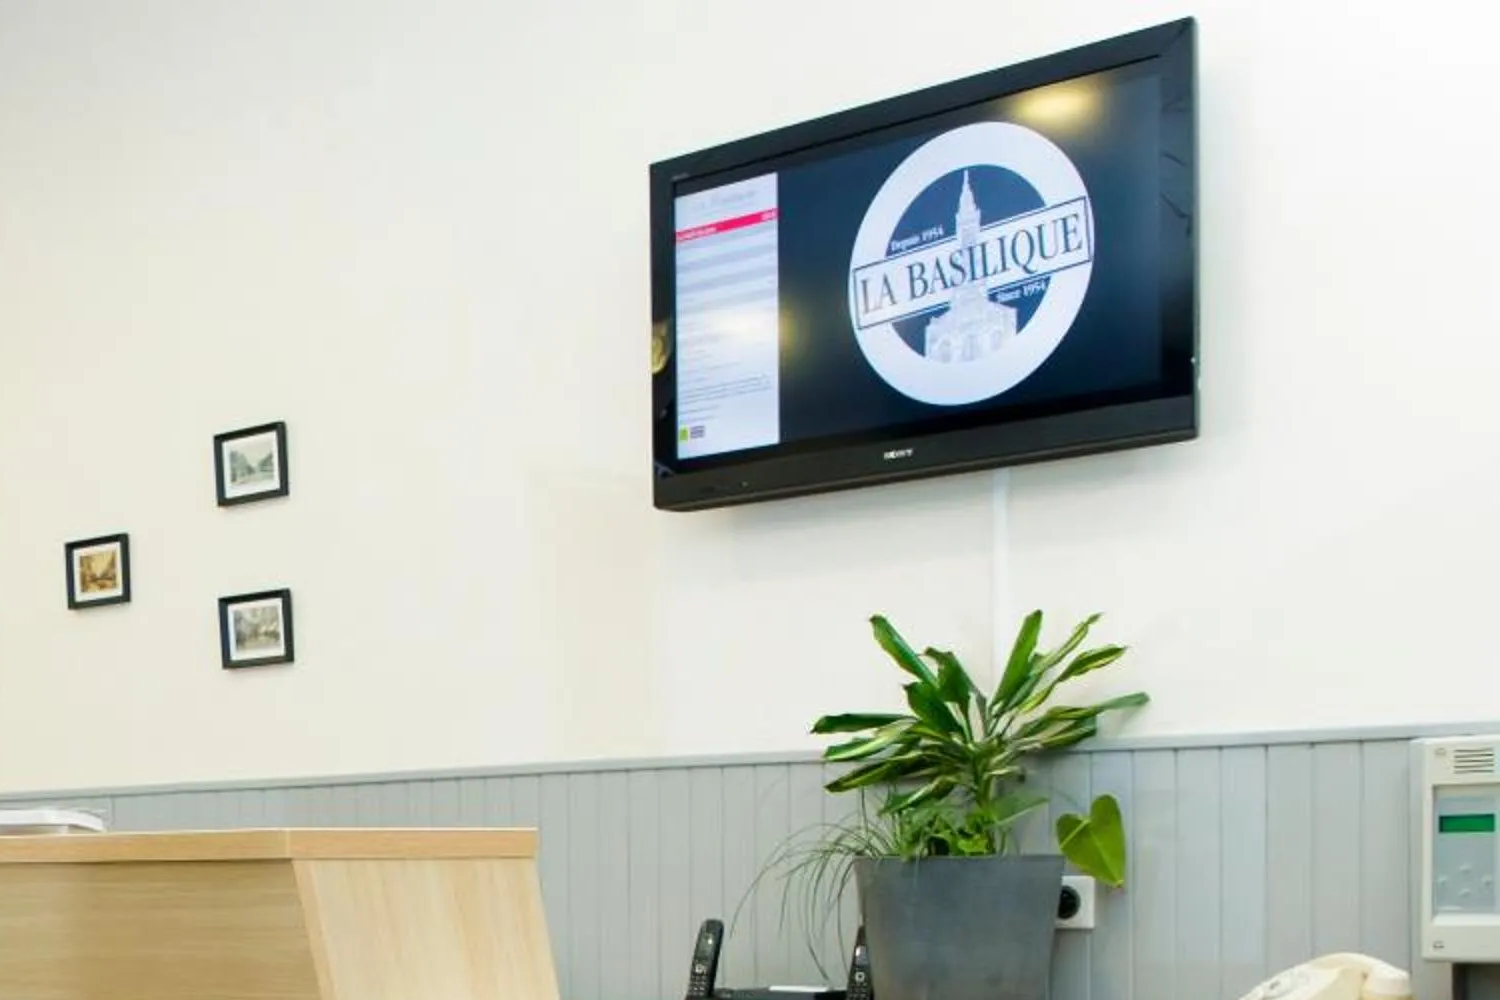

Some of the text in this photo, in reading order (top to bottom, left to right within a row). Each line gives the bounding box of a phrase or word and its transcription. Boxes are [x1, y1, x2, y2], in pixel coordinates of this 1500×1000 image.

[891, 224, 944, 251] Depuis 1954
[860, 213, 1083, 315] LA BASILIQUE
[1022, 280, 1046, 297] 1954
